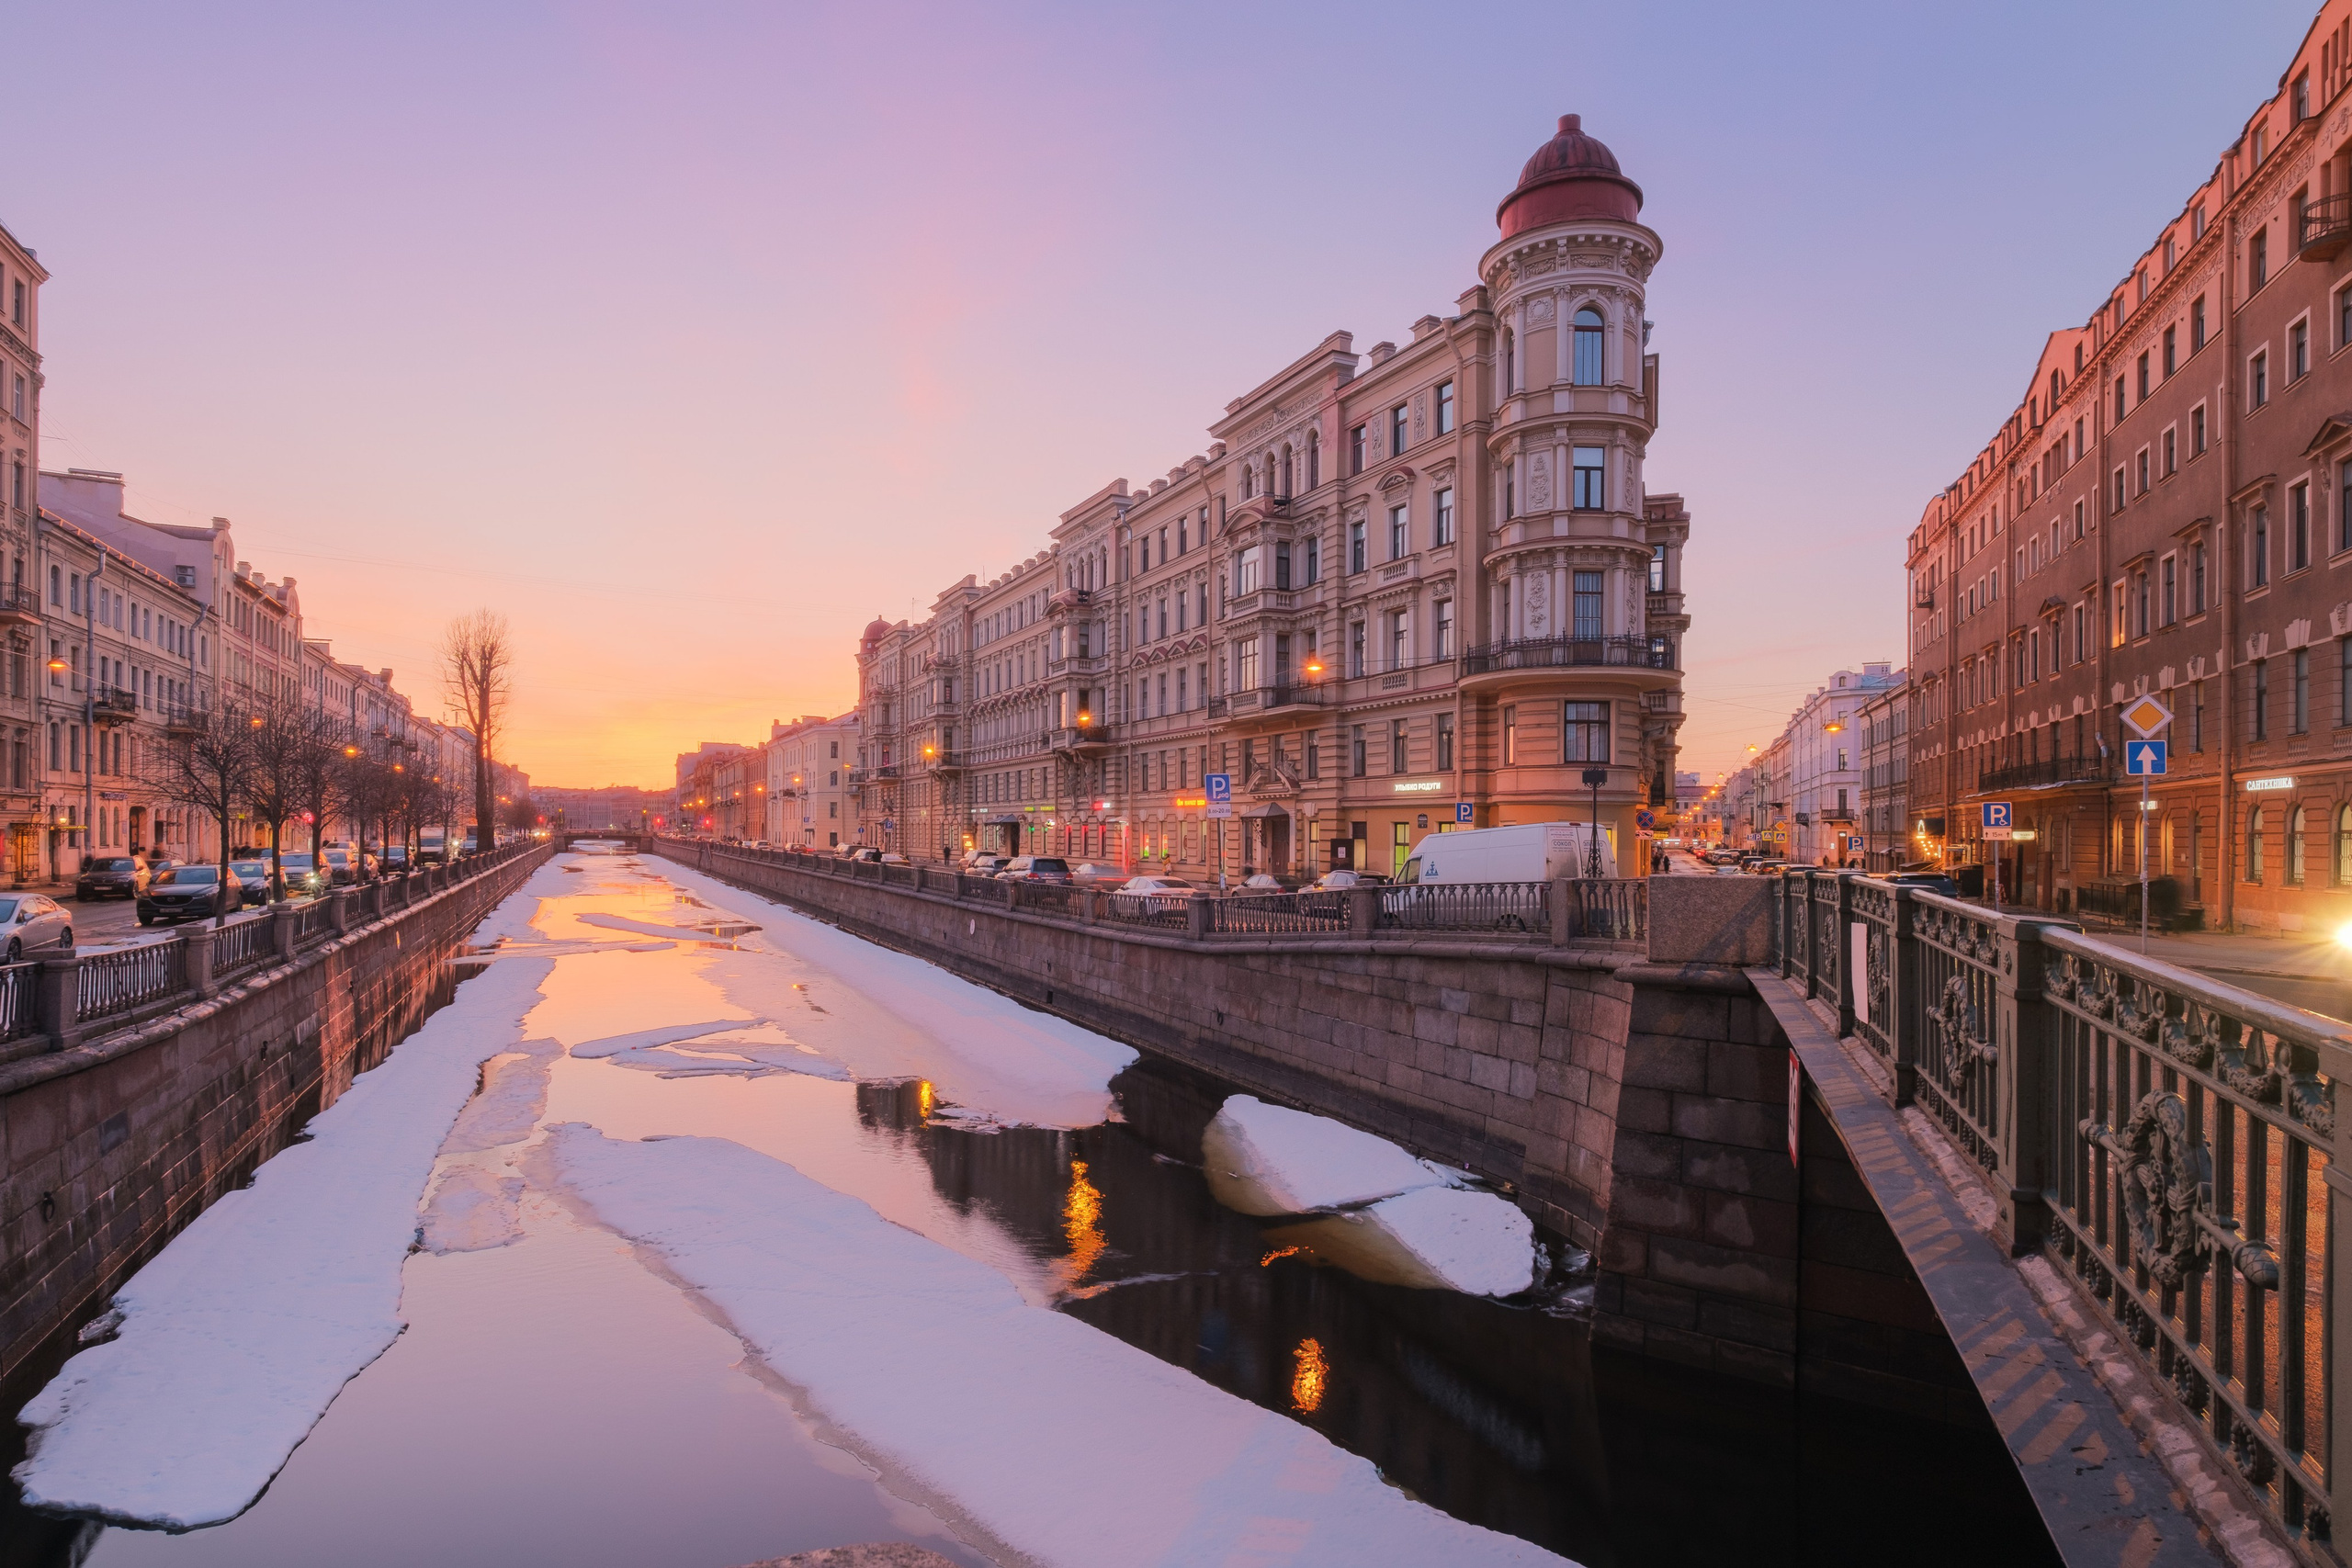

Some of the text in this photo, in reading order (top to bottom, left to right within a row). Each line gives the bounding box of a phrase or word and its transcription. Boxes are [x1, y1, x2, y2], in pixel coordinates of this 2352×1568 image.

[1212, 777, 1226, 798] P
[2246, 776, 2293, 791] САНТЕХНИКА
[1460, 805, 1470, 820] P
[1990, 805, 2007, 825] P
[1851, 838, 1861, 851] P
